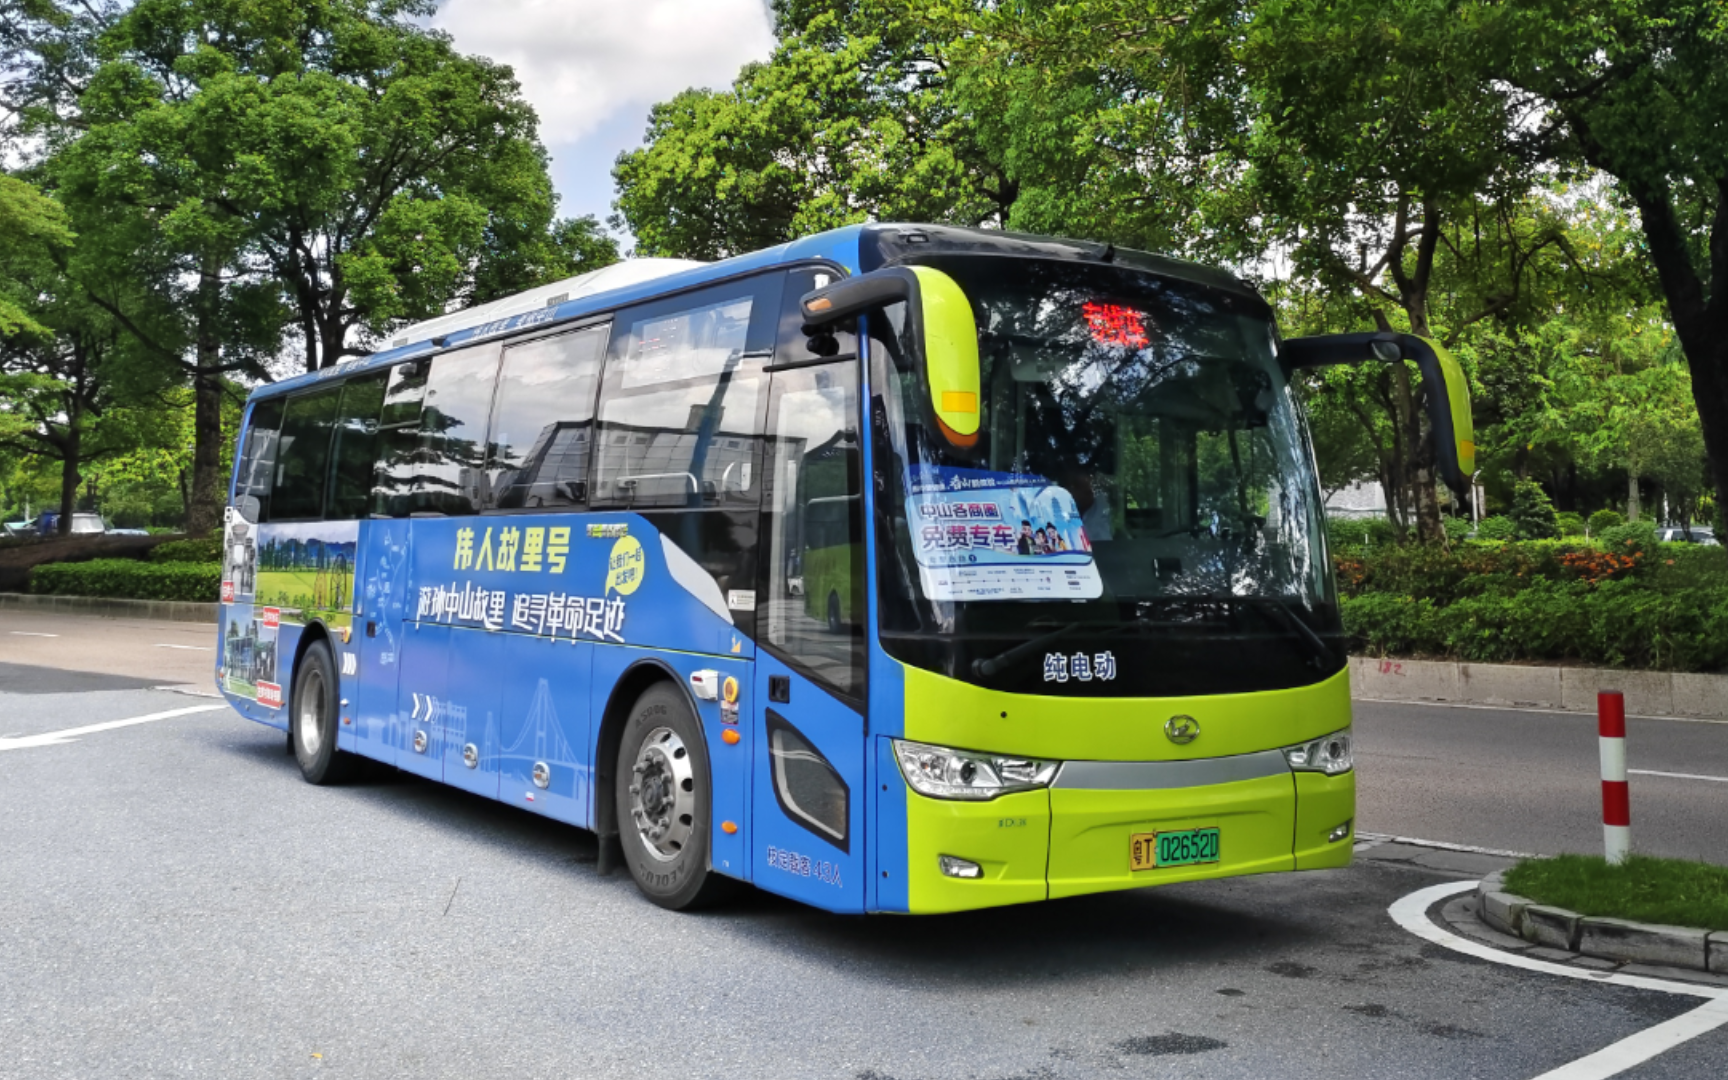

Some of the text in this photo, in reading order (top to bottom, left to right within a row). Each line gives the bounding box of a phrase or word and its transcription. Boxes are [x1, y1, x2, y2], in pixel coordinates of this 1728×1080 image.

[920, 503, 1000, 519] 中山各商圈
[453, 526, 571, 574] 伟人故里号
[921, 524, 1016, 549] 免费专车
[511, 592, 626, 645] 追寻革命足迹
[1043, 650, 1117, 682] 纯电动
[1133, 832, 1219, 866] 粤T 02652D
